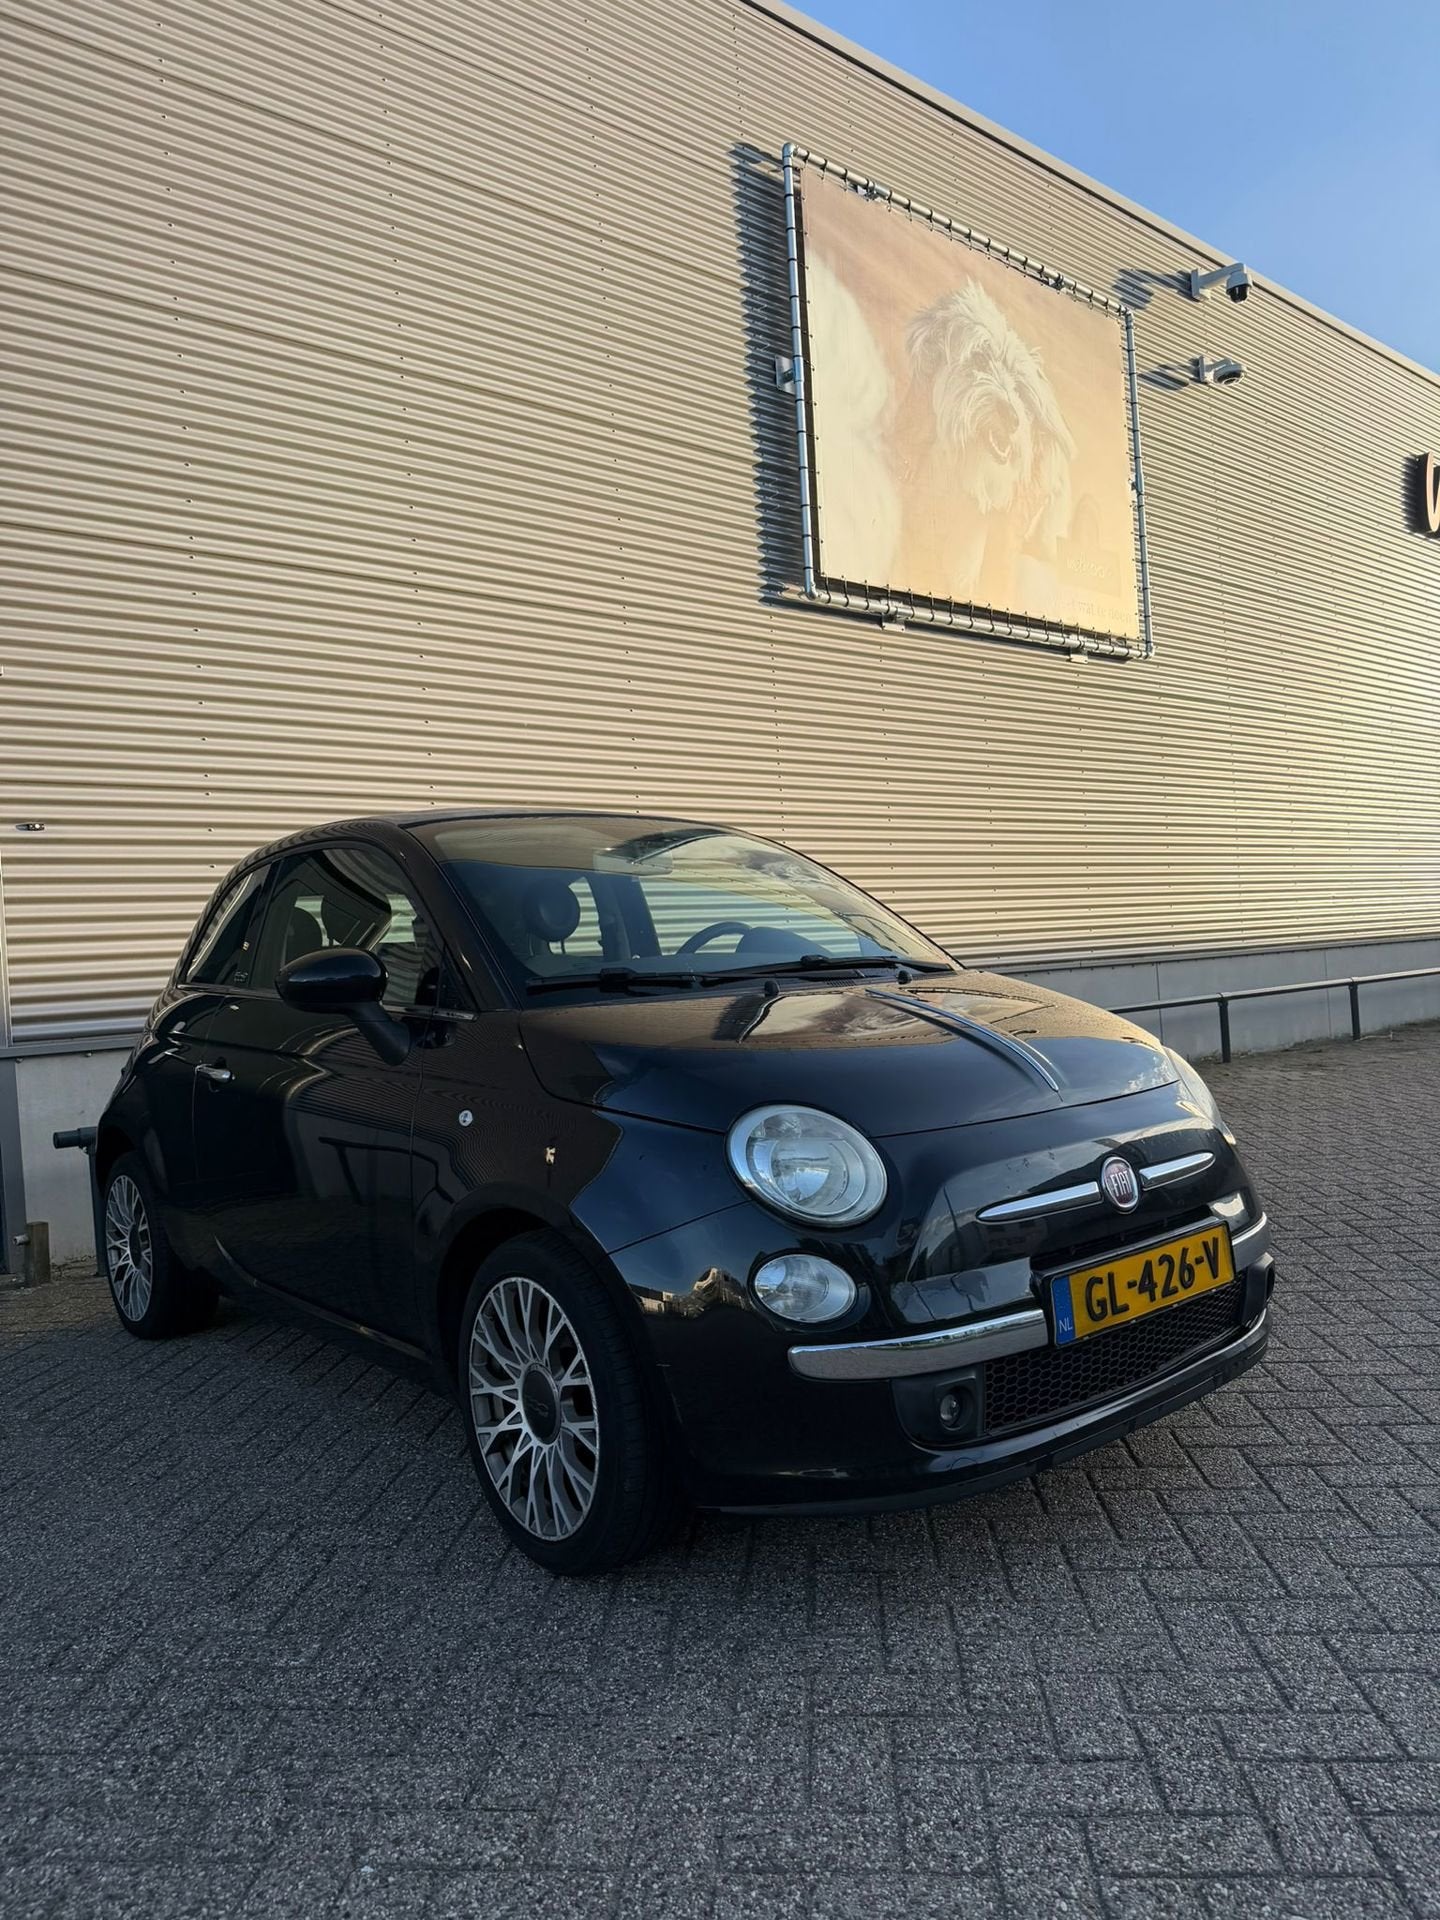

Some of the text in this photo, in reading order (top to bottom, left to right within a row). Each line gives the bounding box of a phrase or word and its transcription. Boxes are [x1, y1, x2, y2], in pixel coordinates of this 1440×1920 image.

[1110, 1169, 1130, 1197] FIAT
[1085, 1237, 1219, 1322] GL-426-V
[1058, 1318, 1073, 1333] NL
